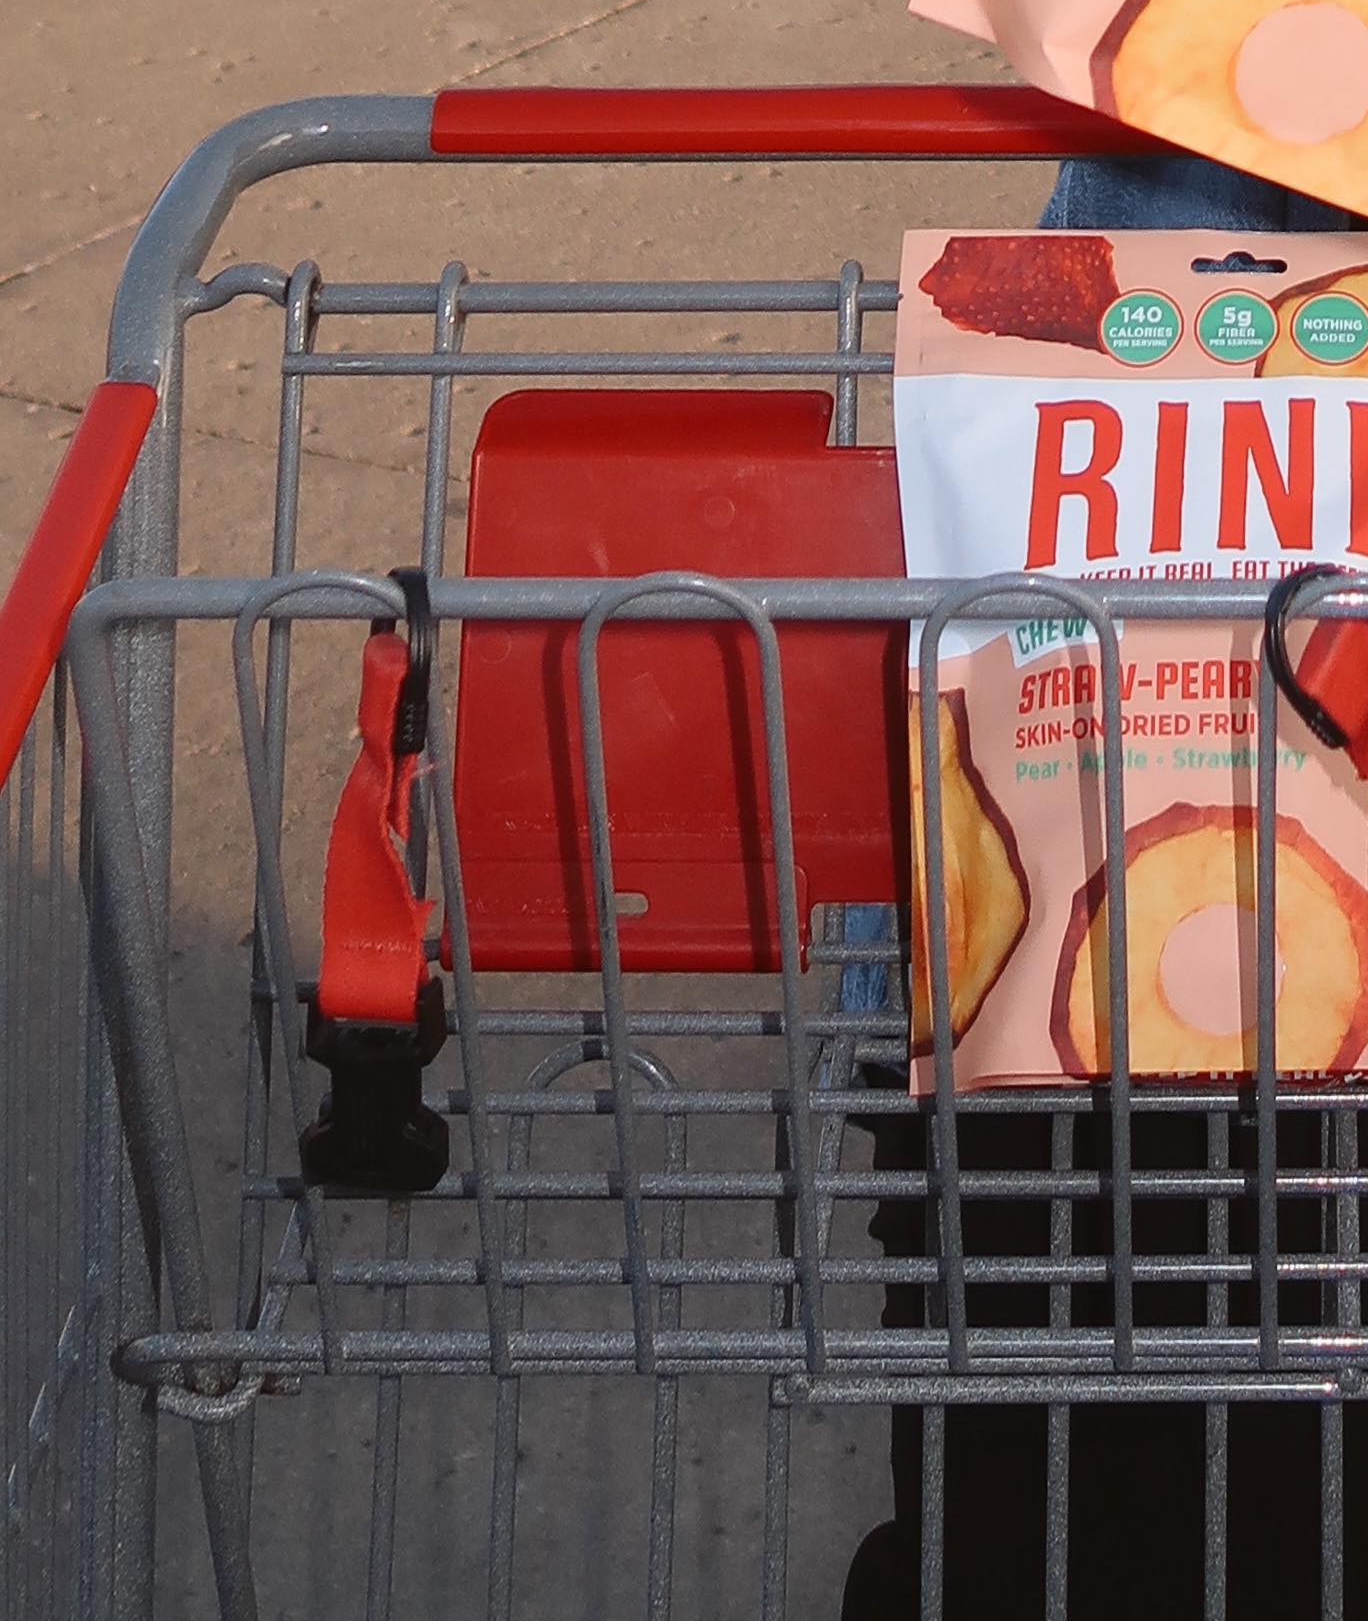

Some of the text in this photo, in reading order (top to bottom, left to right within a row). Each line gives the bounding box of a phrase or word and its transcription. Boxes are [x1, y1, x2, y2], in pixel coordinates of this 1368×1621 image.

[1121, 306, 1162, 324] 140
[1223, 307, 1253, 325] 5g
[1109, 326, 1173, 339] CALORIES
[1217, 327, 1256, 338] FIBER
[1302, 318, 1363, 332] NOTHING
[1309, 332, 1356, 344] ADDED
[1016, 618, 1088, 655] CHEW
[1198, 713, 1255, 735] FRUI
[1015, 759, 1060, 782] Pear
[1081, 748, 1147, 776] Aple
